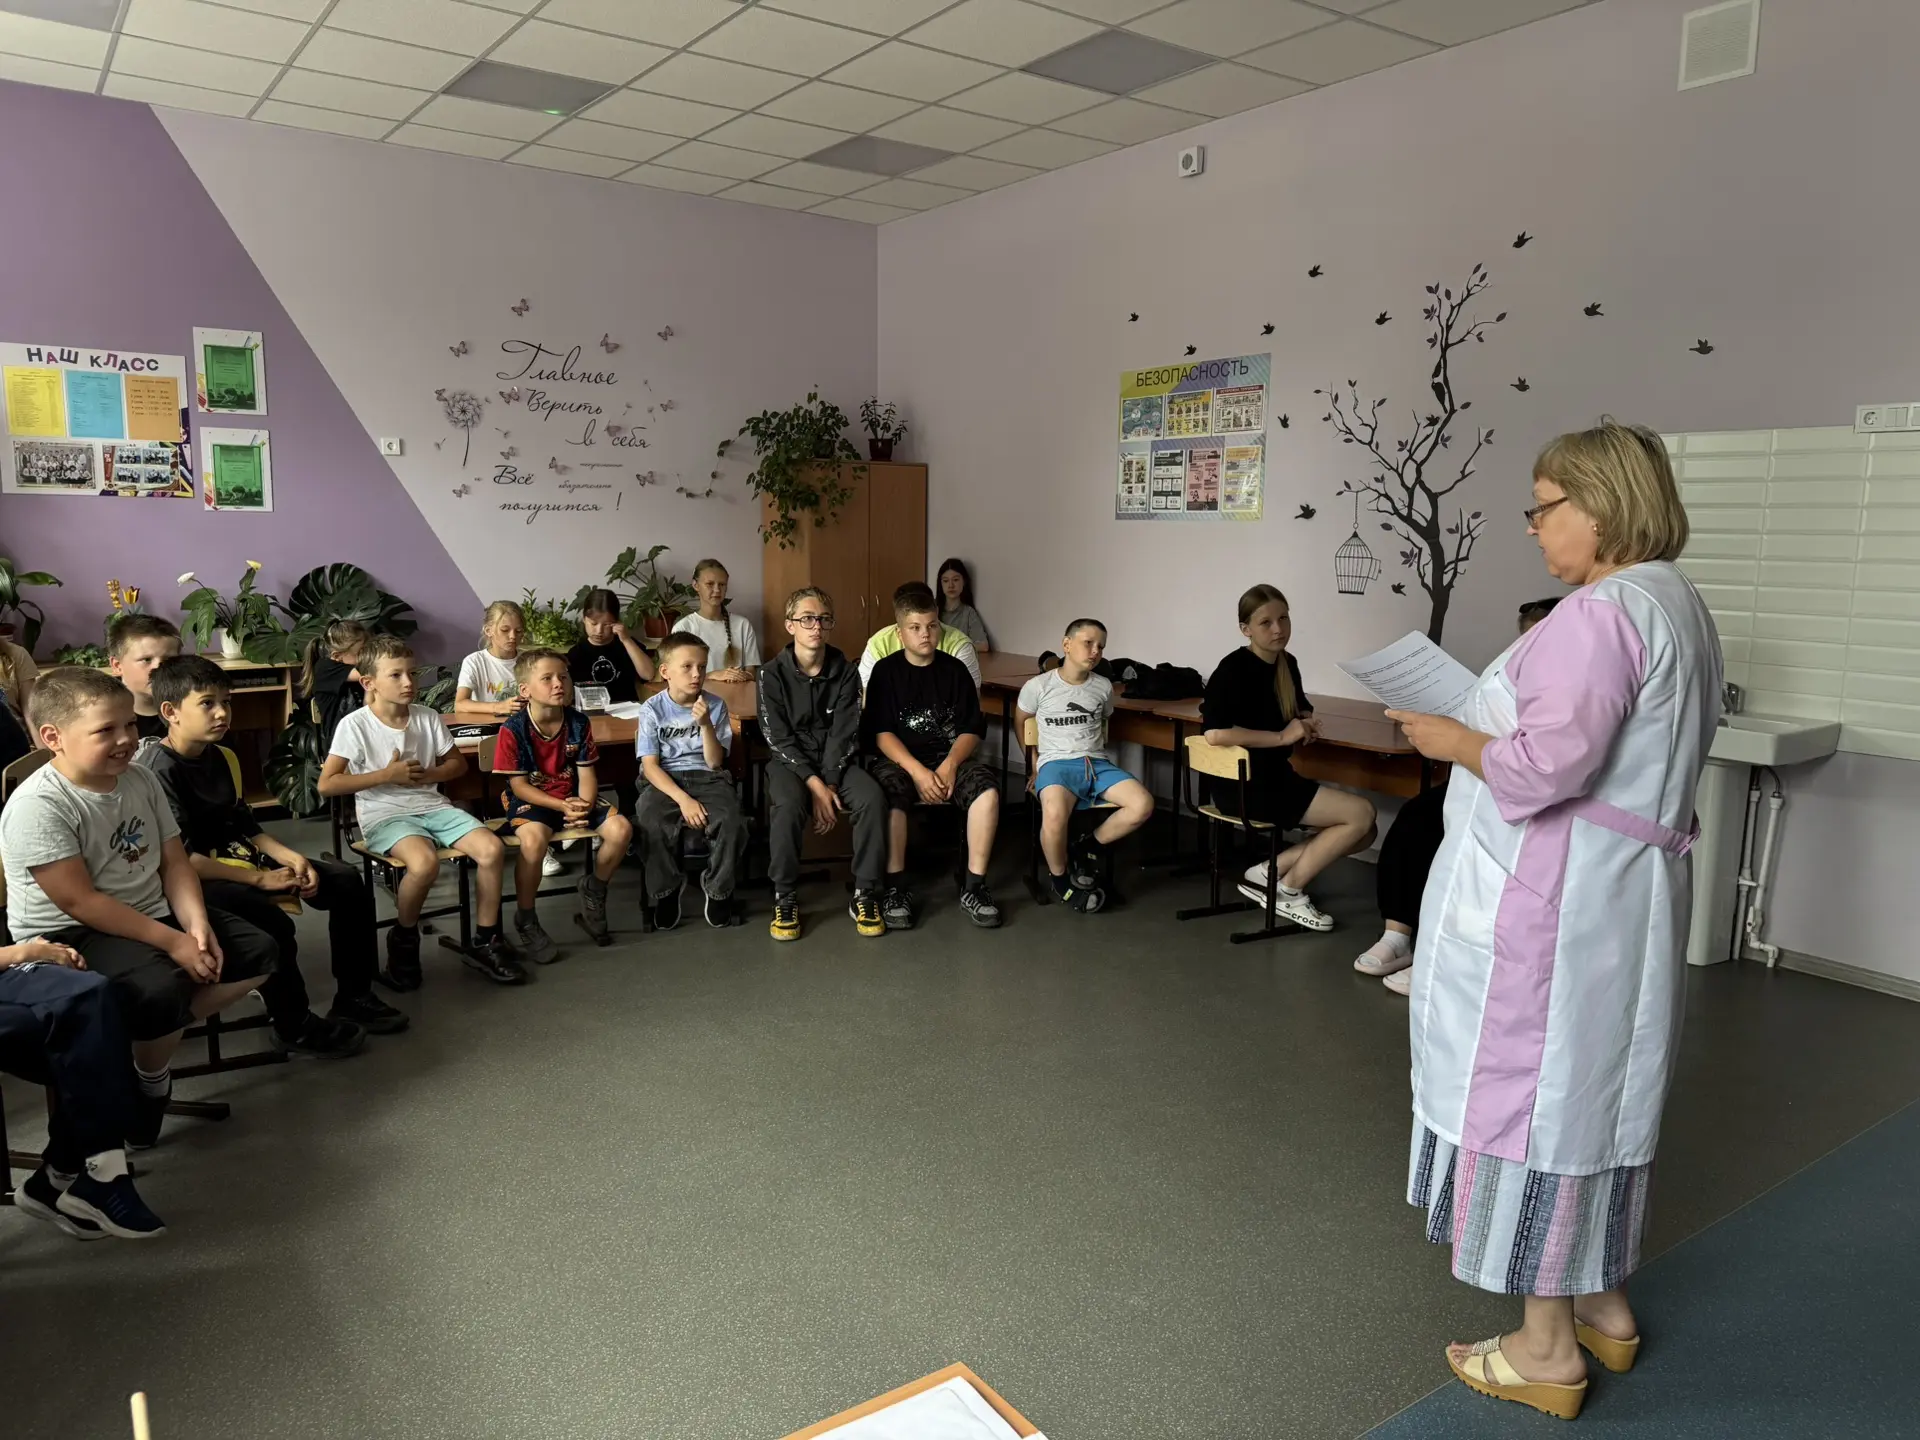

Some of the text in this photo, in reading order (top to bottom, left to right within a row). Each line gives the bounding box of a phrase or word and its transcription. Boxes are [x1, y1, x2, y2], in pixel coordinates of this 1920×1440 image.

[26, 347, 159, 372] НАШ КЛАСС
[496, 339, 619, 385] Главное
[1136, 359, 1249, 388] БЕЗОПАСНОСТЬ
[525, 387, 603, 422] Верить
[564, 418, 651, 449] в себя
[493, 464, 535, 486] Всё
[499, 500, 602, 525] получится
[656, 725, 701, 738] NJOY LI
[1291, 912, 1321, 927] crocs
